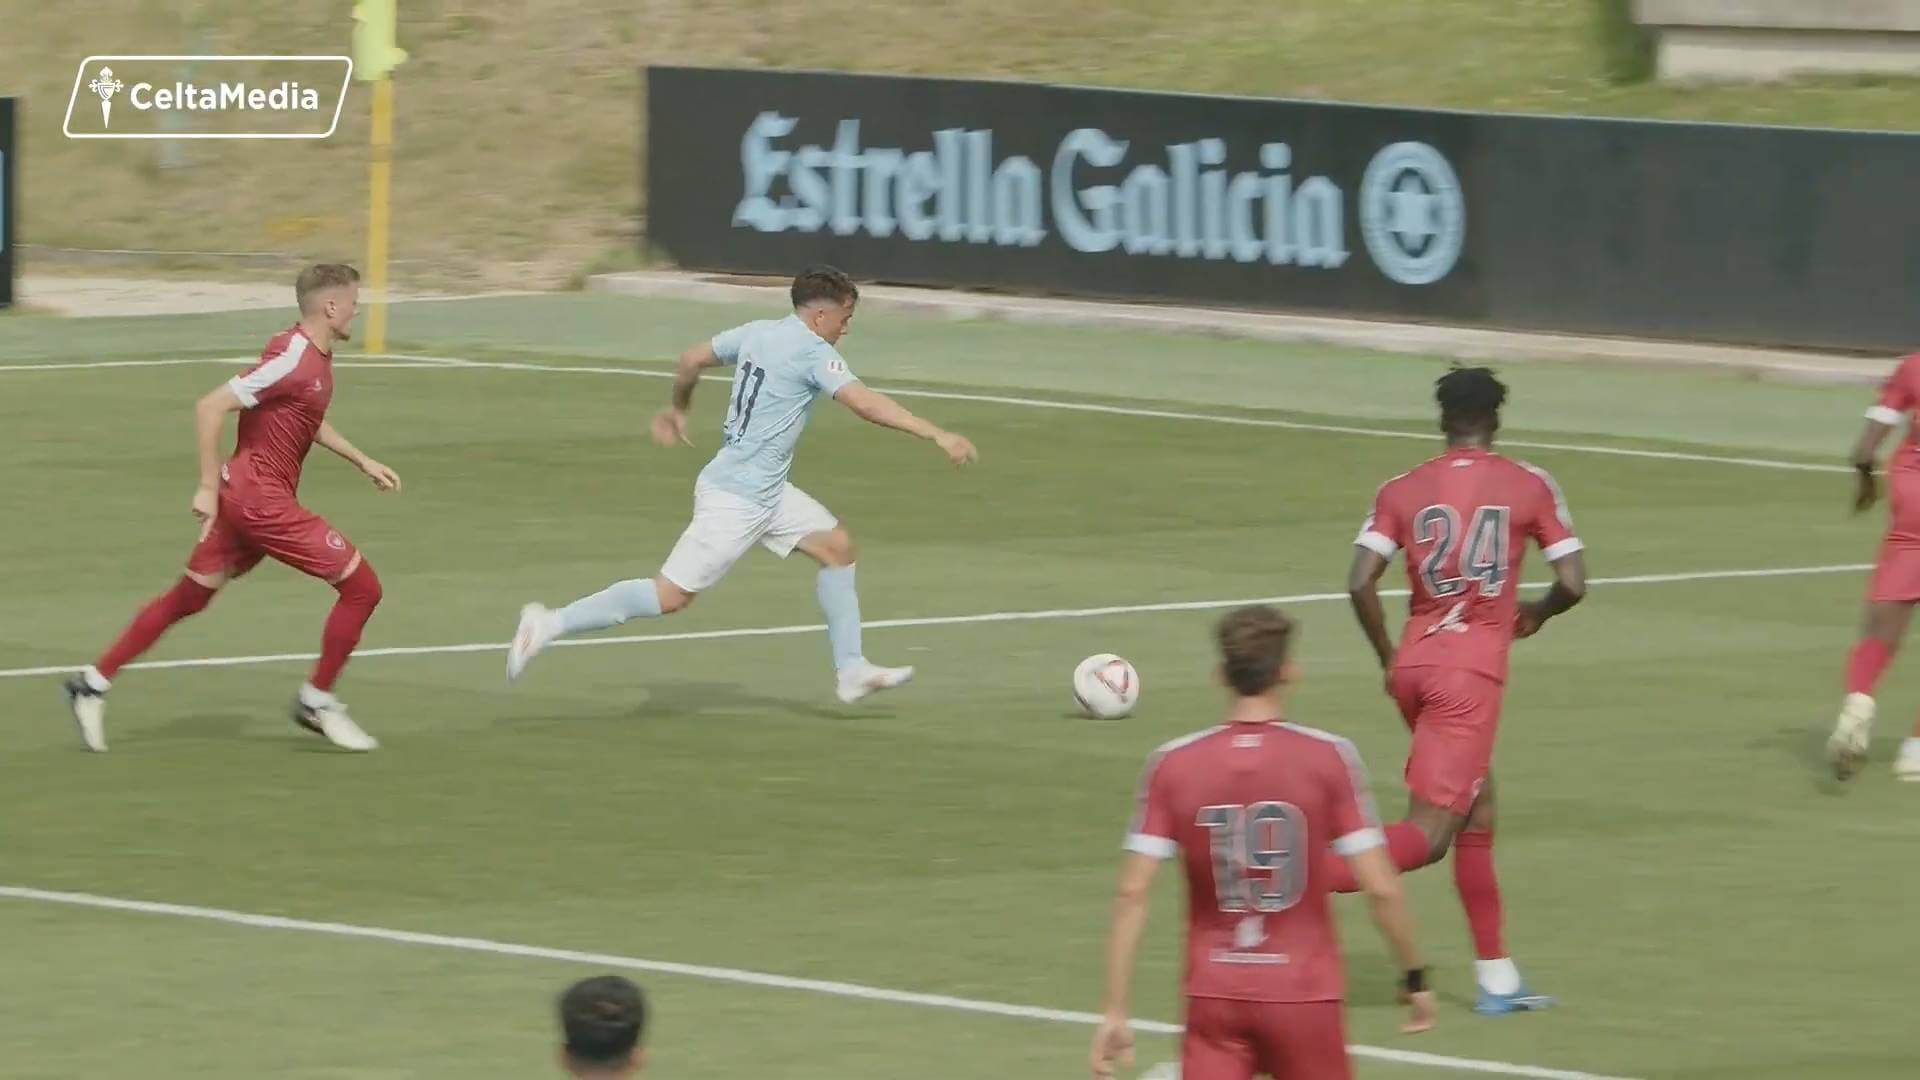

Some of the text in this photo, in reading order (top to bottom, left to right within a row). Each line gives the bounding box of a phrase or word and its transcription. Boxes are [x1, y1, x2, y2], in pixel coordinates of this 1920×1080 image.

[733, 111, 1349, 268] Estrella Galicia
[1412, 504, 1511, 597] 24
[1194, 801, 1309, 912] 19
